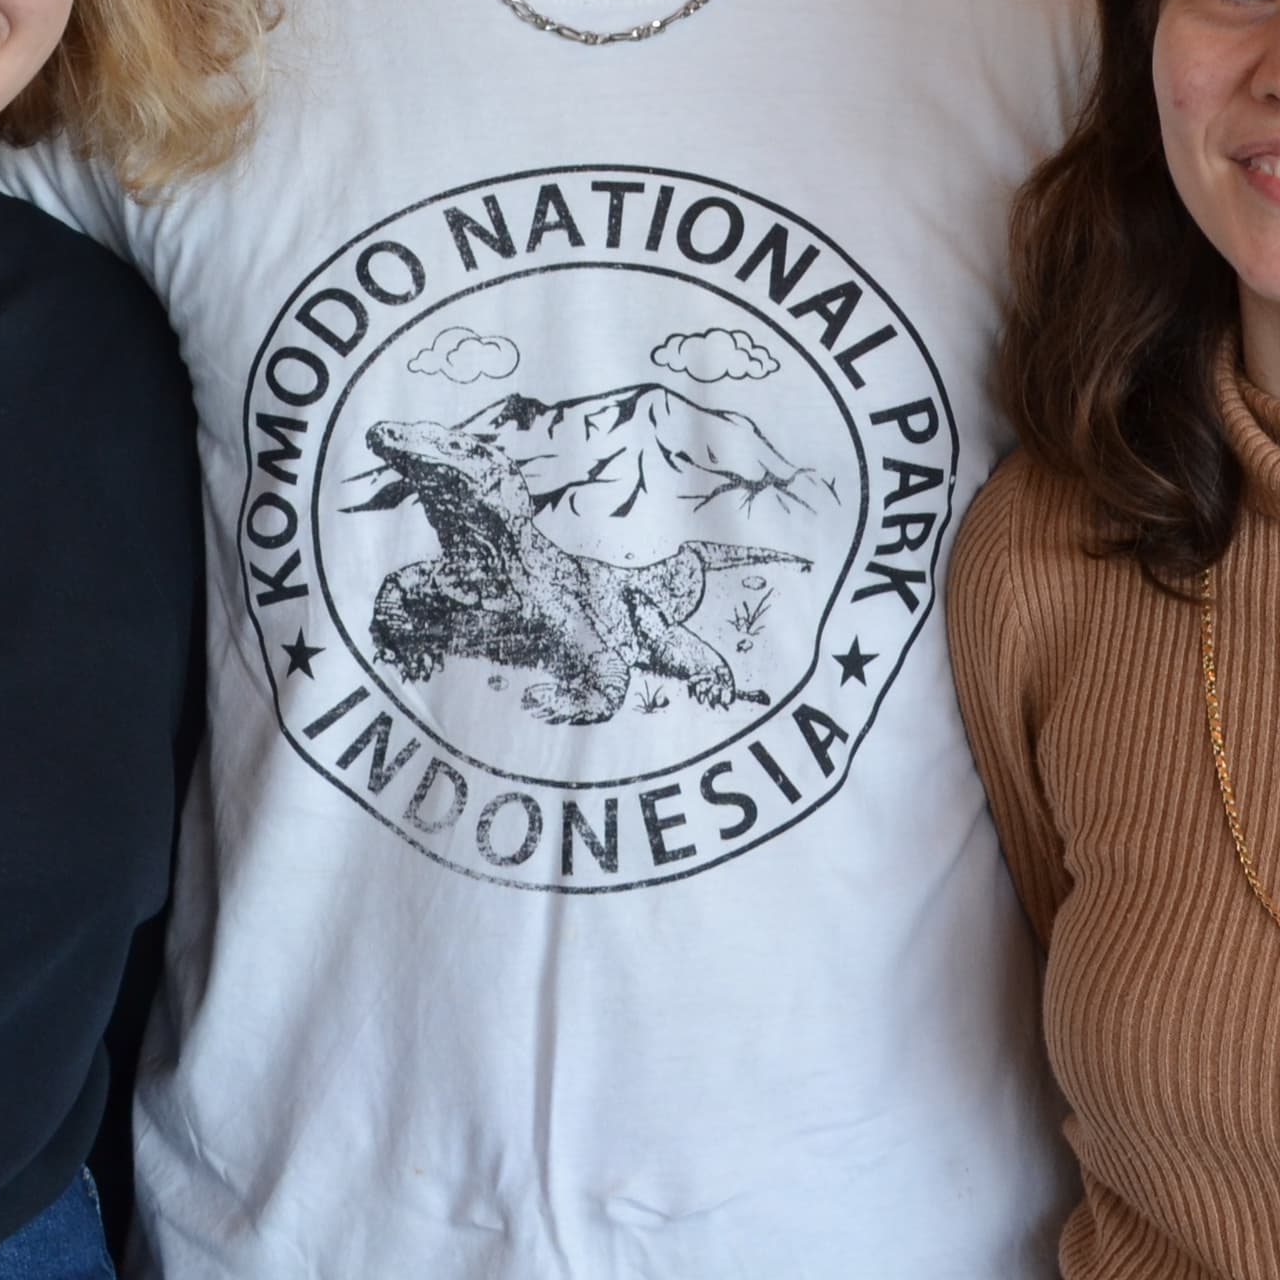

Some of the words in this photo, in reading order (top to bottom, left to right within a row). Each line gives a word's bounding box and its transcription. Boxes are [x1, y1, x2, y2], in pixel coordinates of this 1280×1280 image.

[247, 239, 427, 608] KOMODO
[442, 180, 899, 391] NATIONAL
[850, 396, 944, 614] PARK
[302, 685, 851, 877] INDONESIA
